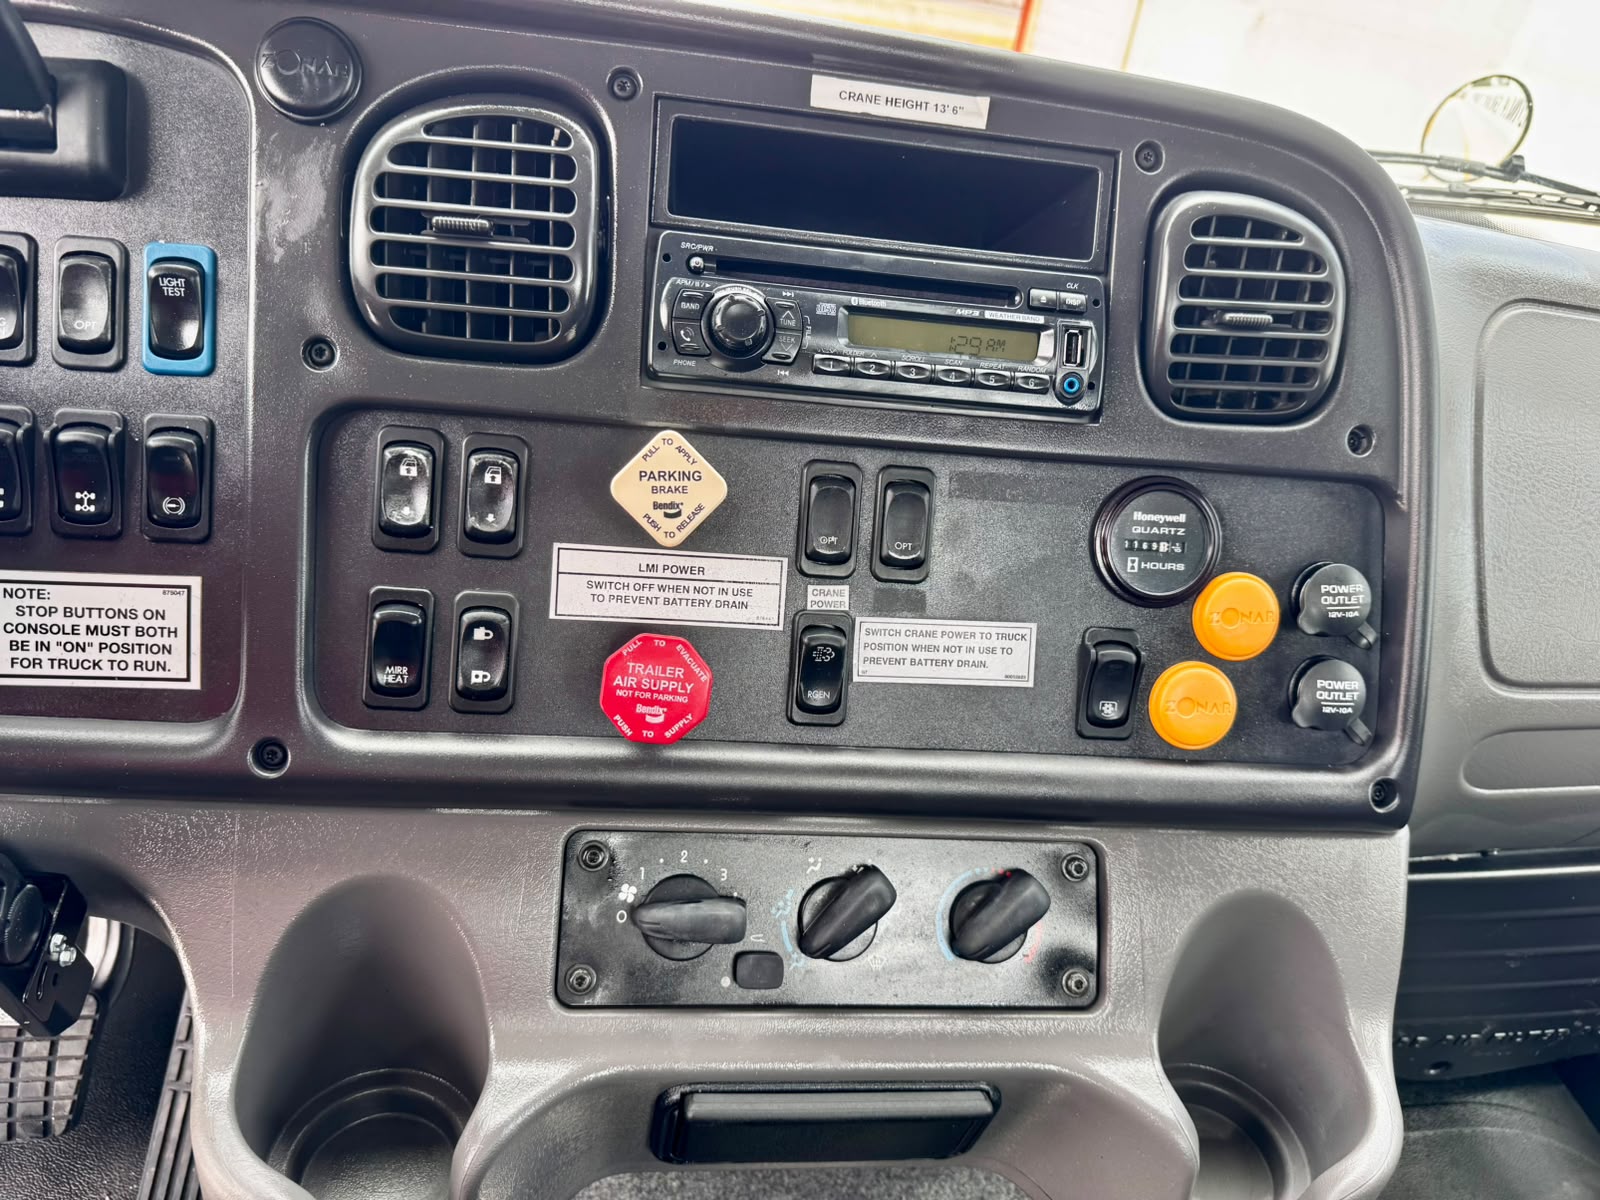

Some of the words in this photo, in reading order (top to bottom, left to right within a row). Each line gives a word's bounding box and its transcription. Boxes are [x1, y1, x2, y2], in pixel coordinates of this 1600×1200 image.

[839, 90, 881, 106] CRANE
[885, 96, 930, 112] HEIGHT
[934, 103, 950, 113] 13'
[681, 242, 714, 251] SRC/PWR
[159, 277, 186, 288] LIGHT
[162, 287, 185, 297] TEST
[681, 302, 699, 310] BAND
[989, 312, 1020, 321] WEATHER
[74, 320, 97, 330] OPT
[780, 319, 796, 327] TUNE
[779, 335, 795, 343] SEEK
[986, 338, 1006, 352] AM
[673, 359, 696, 367] PHONE
[979, 362, 1006, 370] REPEAT
[642, 445, 660, 462] PULL
[662, 438, 673, 446] TO
[675, 445, 698, 466] APPLY
[639, 470, 702, 482] PARKING
[651, 485, 689, 494] BRAKE
[653, 501, 681, 511] Bendix
[643, 513, 662, 532] PUSH
[664, 531, 676, 539] TO
[676, 503, 705, 533] RELEASE
[1133, 511, 1187, 523] Honeywell
[1132, 526, 1186, 536] QUARTZ
[820, 536, 838, 545] OPT
[895, 541, 913, 551] OPT
[638, 563, 659, 573] LMI
[663, 564, 705, 576] POWER
[1141, 562, 1185, 571] HOURS
[3, 587, 51, 600] NOTE:
[586, 580, 630, 592] SWITCH
[633, 582, 655, 593] OFF
[657, 583, 690, 594] WHEN
[693, 585, 715, 596] NOT
[718, 586, 730, 596] IN
[732, 587, 753, 598] USE
[811, 588, 846, 598] CRANE
[1320, 584, 1363, 594] POWER
[590, 593, 605, 603] TO
[608, 594, 661, 606] PREVENT
[663, 596, 712, 608] BATTERY
[715, 599, 749, 610] DRAIN
[810, 600, 846, 609] POWER
[1321, 595, 1365, 605] OUTLET
[15, 605, 58, 618] STOP
[63, 606, 139, 620] BUTTONS
[143, 609, 166, 621] ON
[1208, 607, 1275, 630] ZONAR
[3, 622, 81, 636] CONSOLE
[86, 624, 130, 637] MUST
[135, 626, 178, 638] BOTH
[865, 628, 901, 638] SWITCH
[904, 629, 938, 639] CRANE
[940, 631, 976, 640] POWER
[979, 632, 992, 640] TO
[995, 632, 1027, 641] TRUCK
[9, 640, 30, 652] BE
[35, 640, 51, 652] IN
[56, 641, 93, 653] "ON"
[99, 642, 172, 655] POSITION
[864, 643, 908, 652] POSITION
[911, 644, 940, 653] WHEN
[943, 645, 963, 654] NOT
[966, 646, 975, 654] IN
[978, 647, 997, 655] USE
[1000, 647, 1013, 655] TO
[10, 657, 43, 670] FOR
[47, 658, 103, 671] TRUCK
[107, 659, 129, 671] TO
[133, 660, 171, 673] RUN.
[622, 640, 642, 656] PULL
[653, 639, 666, 647] TO
[676, 644, 708, 683] EVACUATE
[863, 657, 907, 666] PREVENT
[910, 658, 954, 668] BATTERY
[956, 660, 989, 669] DRAIN.
[384, 666, 409, 675] MIRR
[627, 662, 685, 679] TRAILER
[384, 675, 409, 684] HEAT
[613, 676, 637, 688] AIR
[641, 678, 694, 694] SUPPLY
[1316, 680, 1359, 690] POWER
[616, 689, 633, 698] NOT
[634, 690, 651, 700] FOR
[653, 693, 689, 704] PARKING
[807, 690, 831, 699] RGEN
[1316, 691, 1360, 700] OUTLET
[1164, 696, 1231, 718] ZONAR
[1322, 706, 1353, 714] 12V-10A
[613, 714, 633, 737] PUSH
[642, 730, 654, 738] TO
[664, 713, 693, 739] SUPPLY
[680, 850, 688, 863] 2
[720, 868, 728, 881] 3
